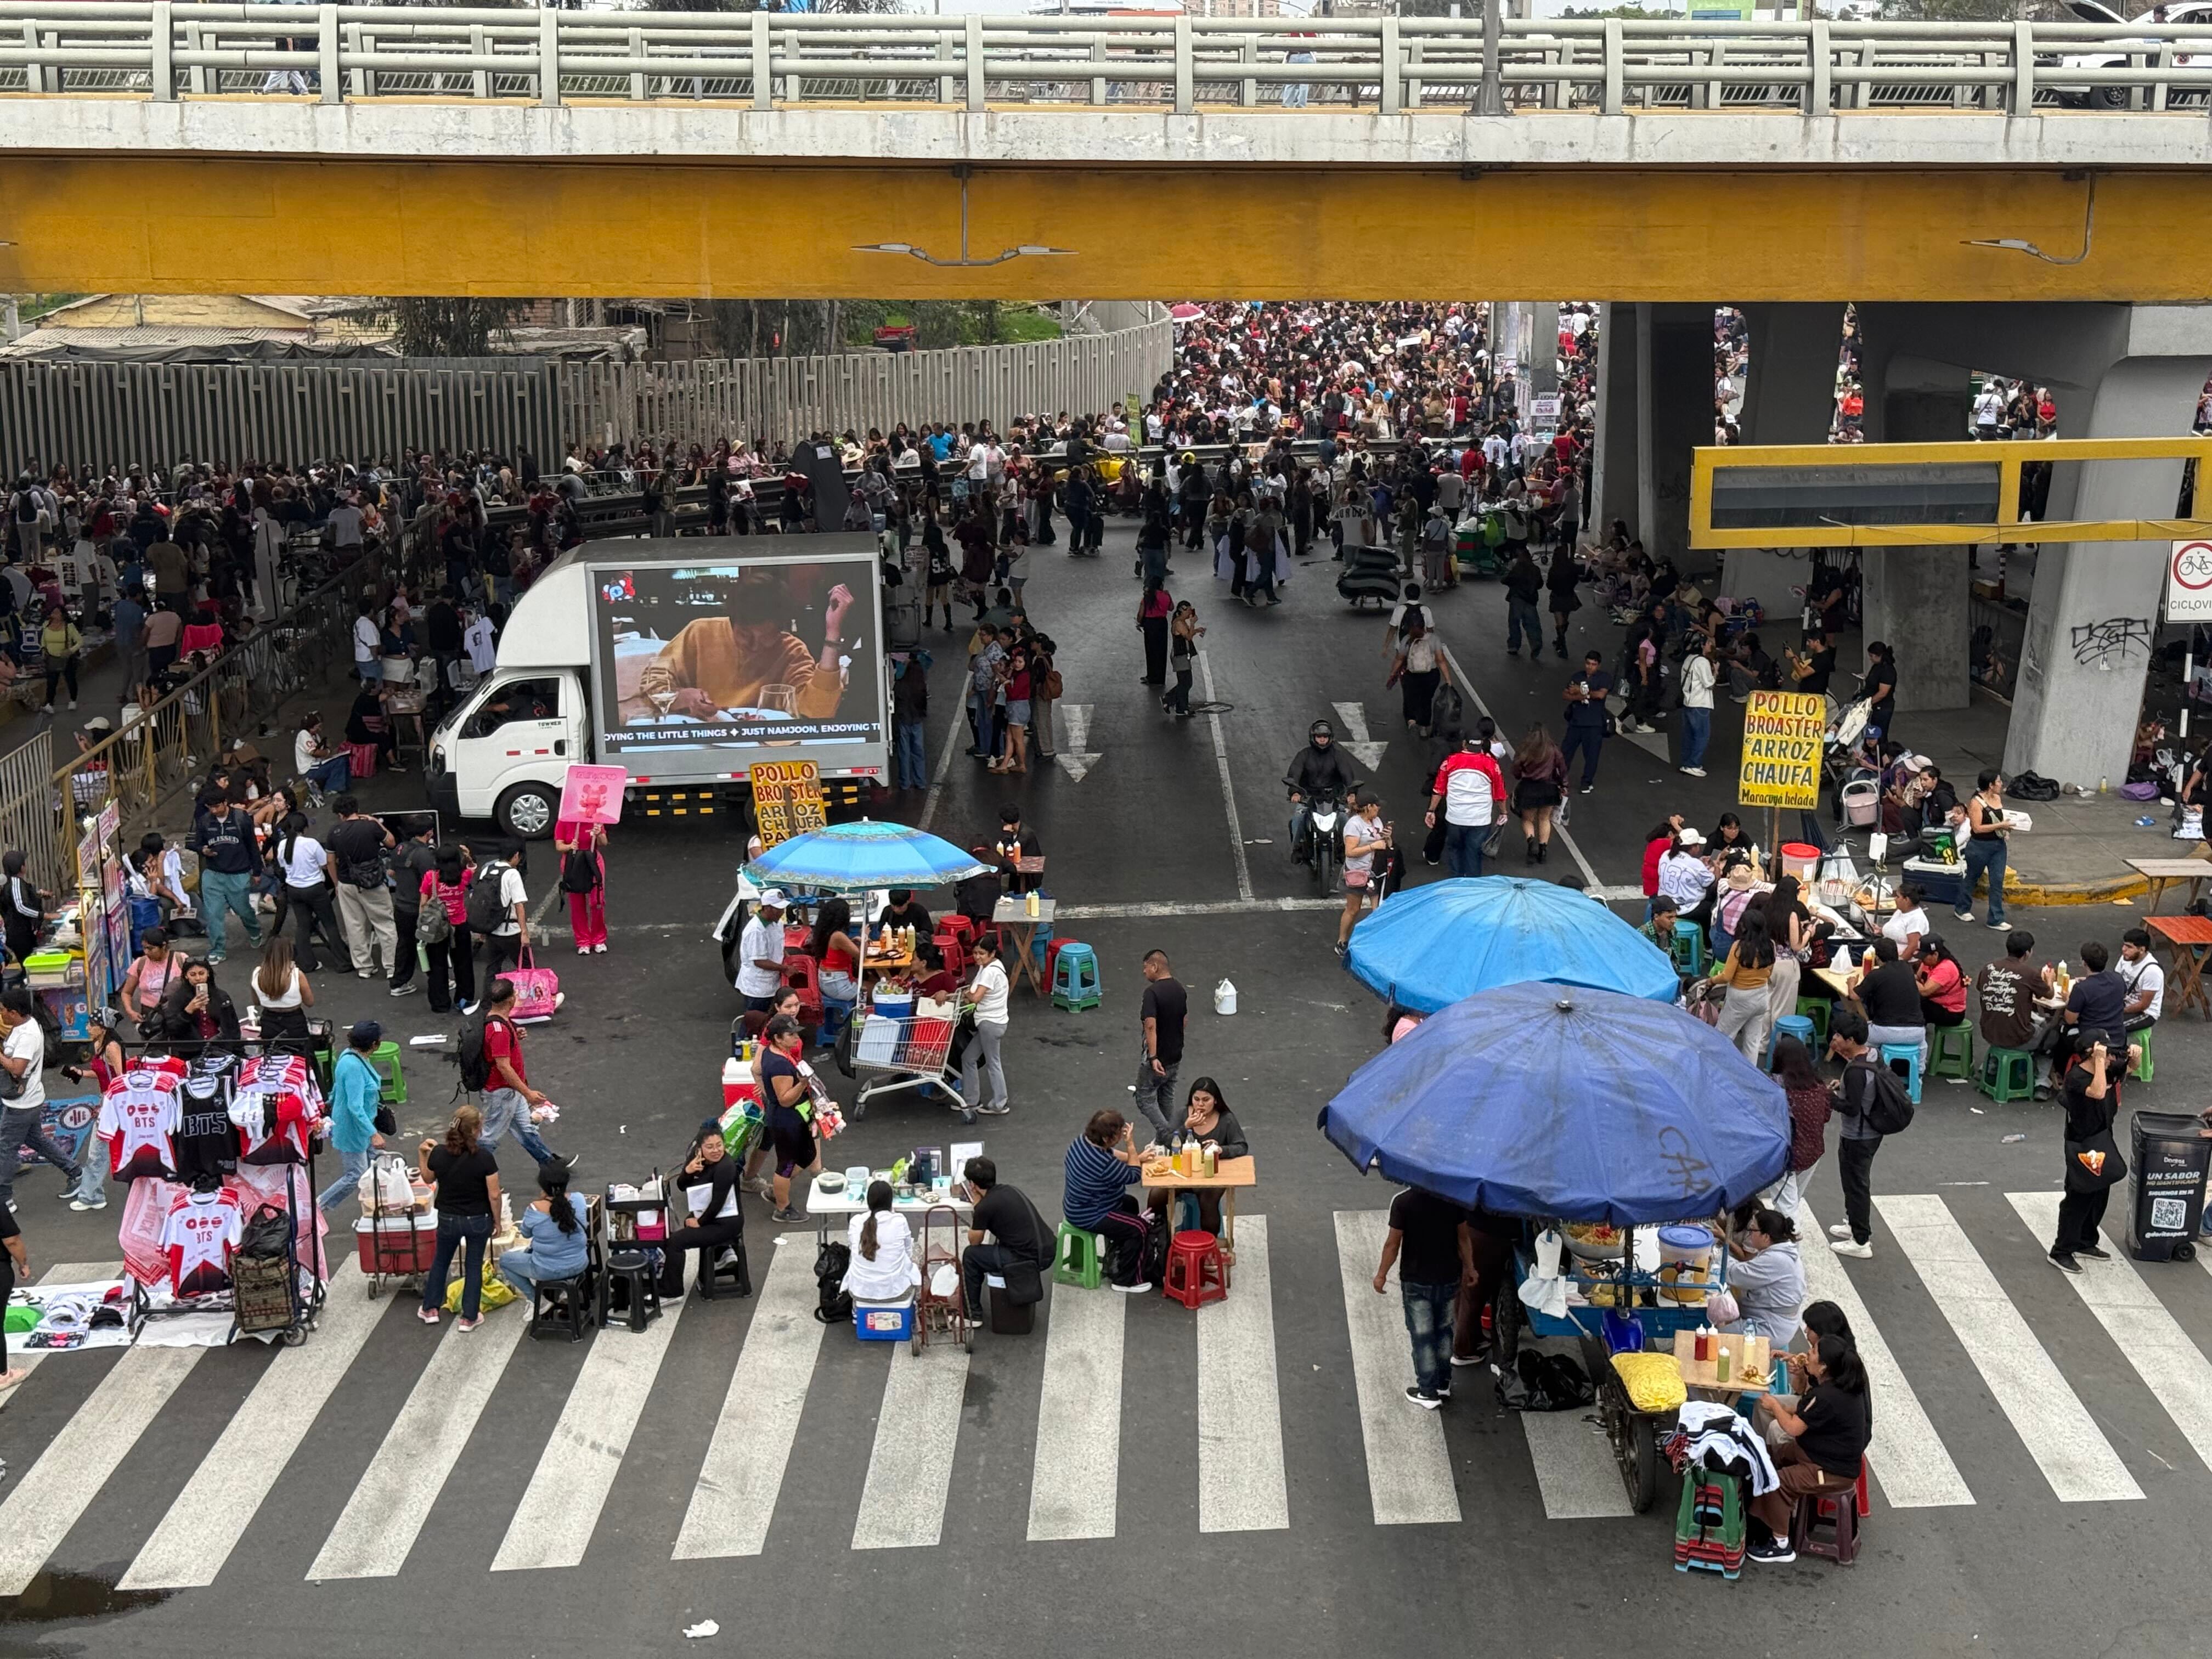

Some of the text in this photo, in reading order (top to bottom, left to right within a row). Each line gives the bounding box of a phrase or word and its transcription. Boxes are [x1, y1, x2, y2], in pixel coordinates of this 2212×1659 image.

[2170, 600, 2212, 611] CICLOVI
[1754, 693, 1818, 716] POLLO
[636, 731, 656, 740] THE
[658, 730, 690, 739] LITTLE
[691, 729, 727, 738] THINGS
[741, 727, 765, 736] JUST
[768, 725, 819, 735] NAMJOON,
[821, 723, 870, 732] ENJOYING
[1746, 715, 1822, 739] BROASTER
[1751, 739, 1815, 761] ARROZ
[754, 763, 816, 783] POLLO
[1742, 762, 1813, 787] CHAUFA
[755, 782, 822, 803] BROSTER
[1784, 792, 1814, 806] helada
[760, 803, 821, 819] AROZ
[762, 816, 826, 832] CHUFA
[1660, 861, 1682, 895] 13
[134, 1117, 155, 1128] BTS
[183, 1112, 228, 1138] BTS
[2164, 1171, 2200, 1180] SABOR
